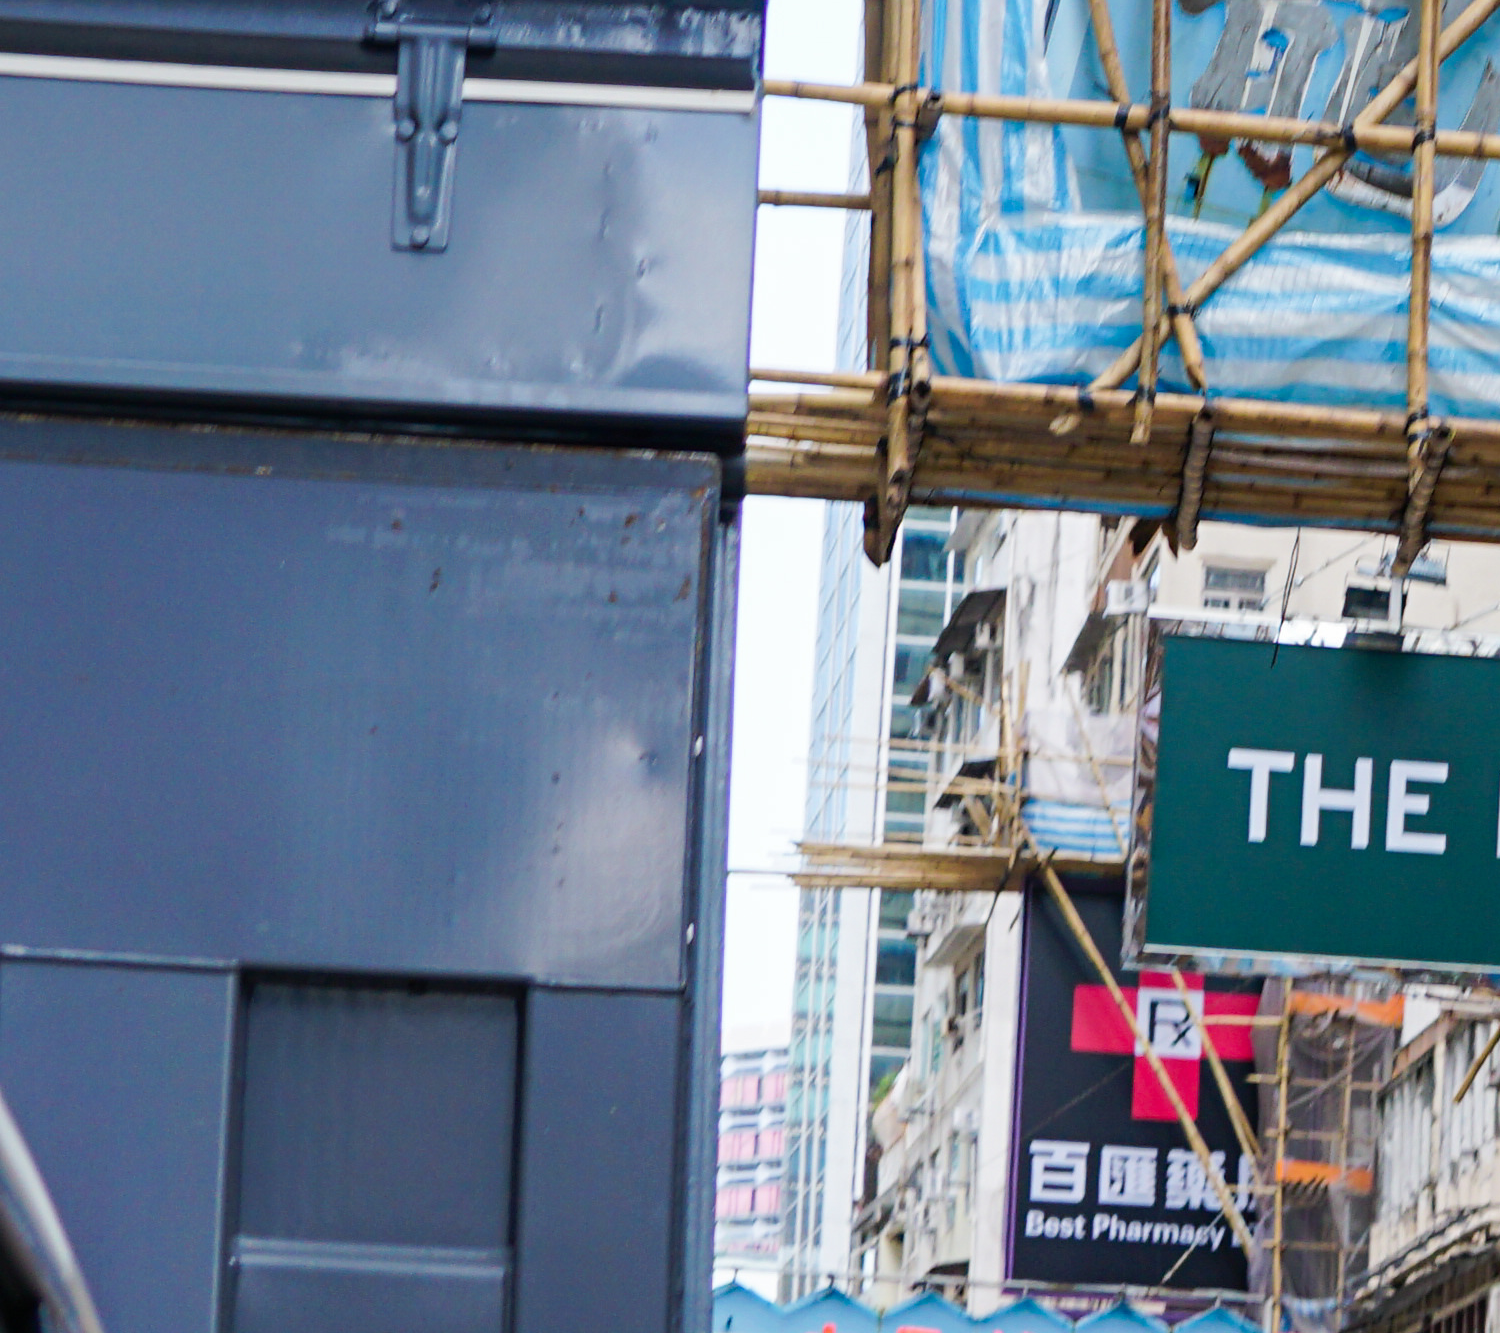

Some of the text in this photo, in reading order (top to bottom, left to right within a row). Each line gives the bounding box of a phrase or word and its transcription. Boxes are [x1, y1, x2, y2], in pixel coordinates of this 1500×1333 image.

[1227, 748, 1449, 855] THE
[1025, 1210, 1087, 1239] Best
[1092, 1213, 1225, 1252] Pharmacy
